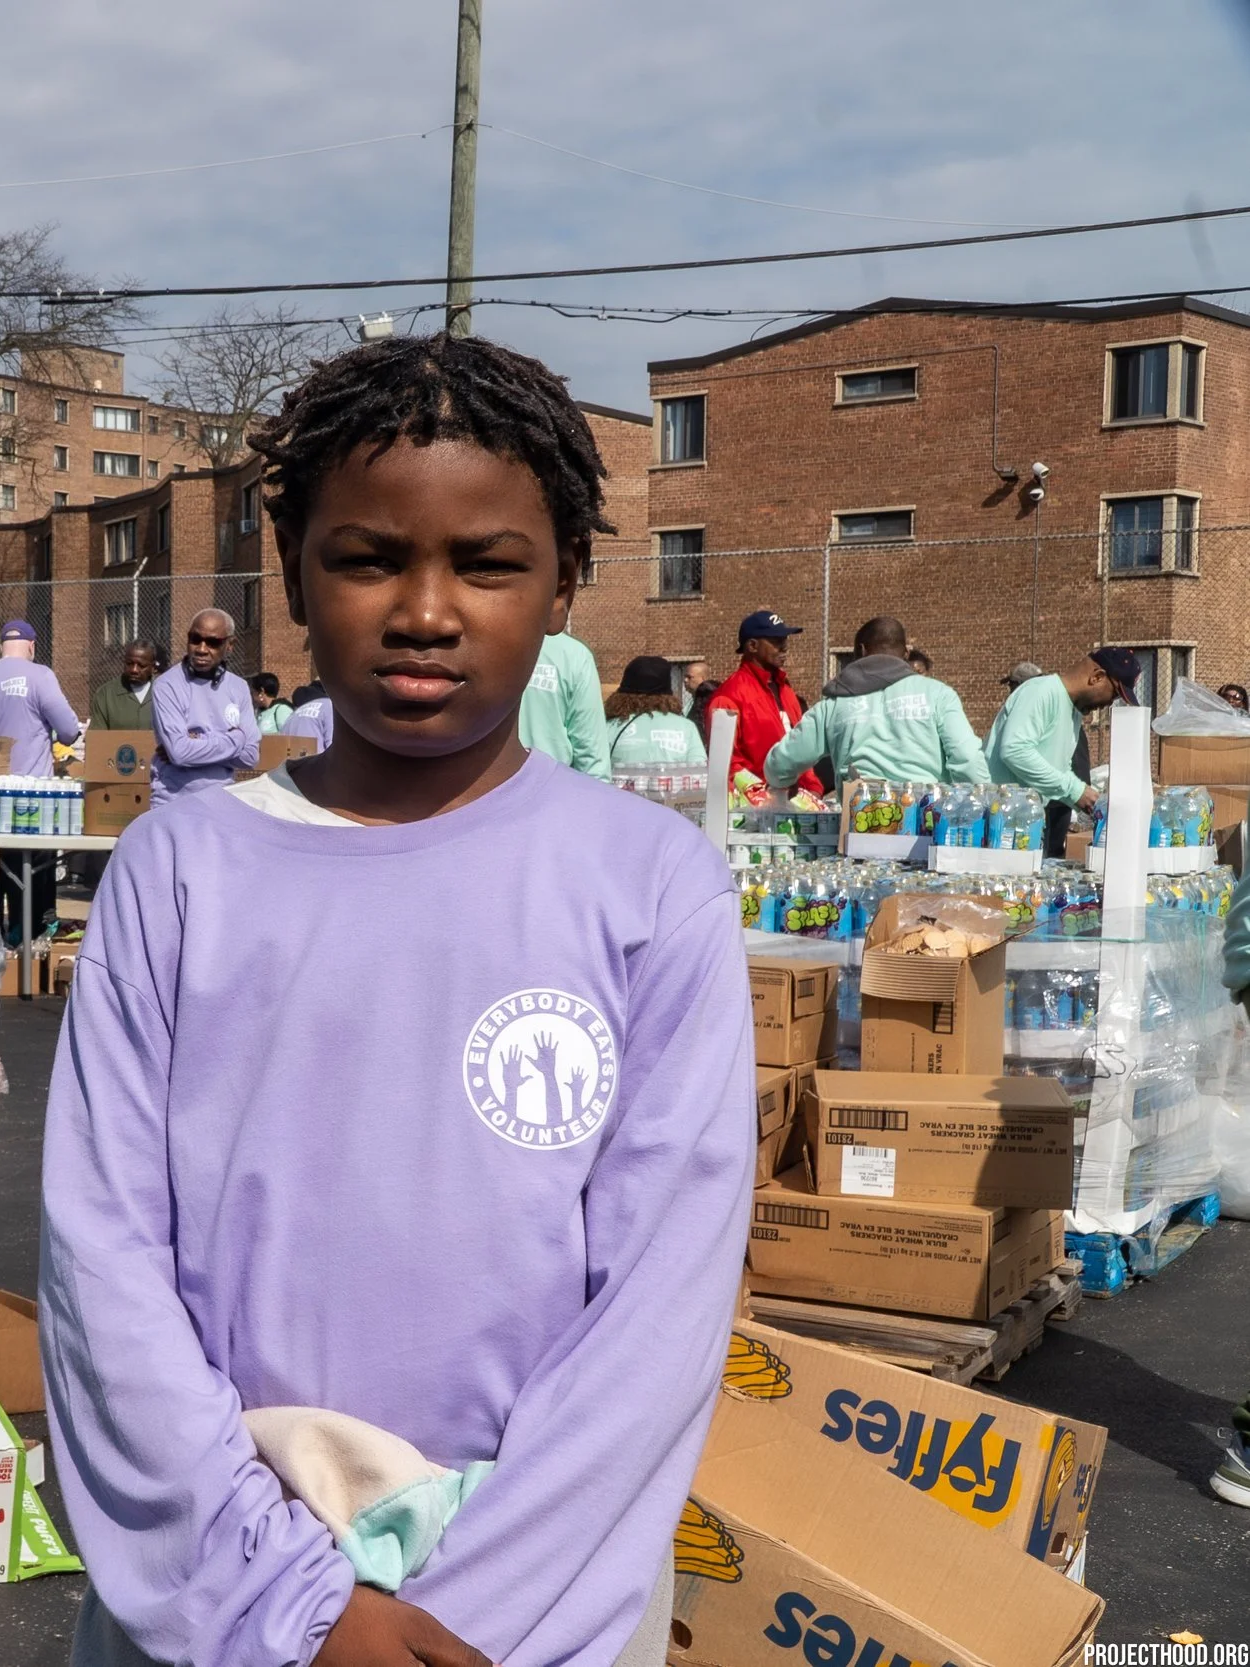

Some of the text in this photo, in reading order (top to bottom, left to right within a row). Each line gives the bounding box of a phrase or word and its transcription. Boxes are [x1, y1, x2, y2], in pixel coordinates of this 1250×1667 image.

[469, 993, 615, 1077] EVERYBODY EATS
[480, 1096, 606, 1144] VOLUNTEER
[920, 1121, 943, 1129] VRAC
[827, 1133, 852, 1144] 28101
[931, 1130, 975, 1138] CRACKERS
[978, 1132, 1007, 1140] WHEAT
[840, 1221, 862, 1230] VRAC
[753, 1228, 777, 1240] 28101
[850, 1230, 948, 1248] BULK WHEAT CRACKERS
[907, 1229, 959, 1241] CRAQUELINS
